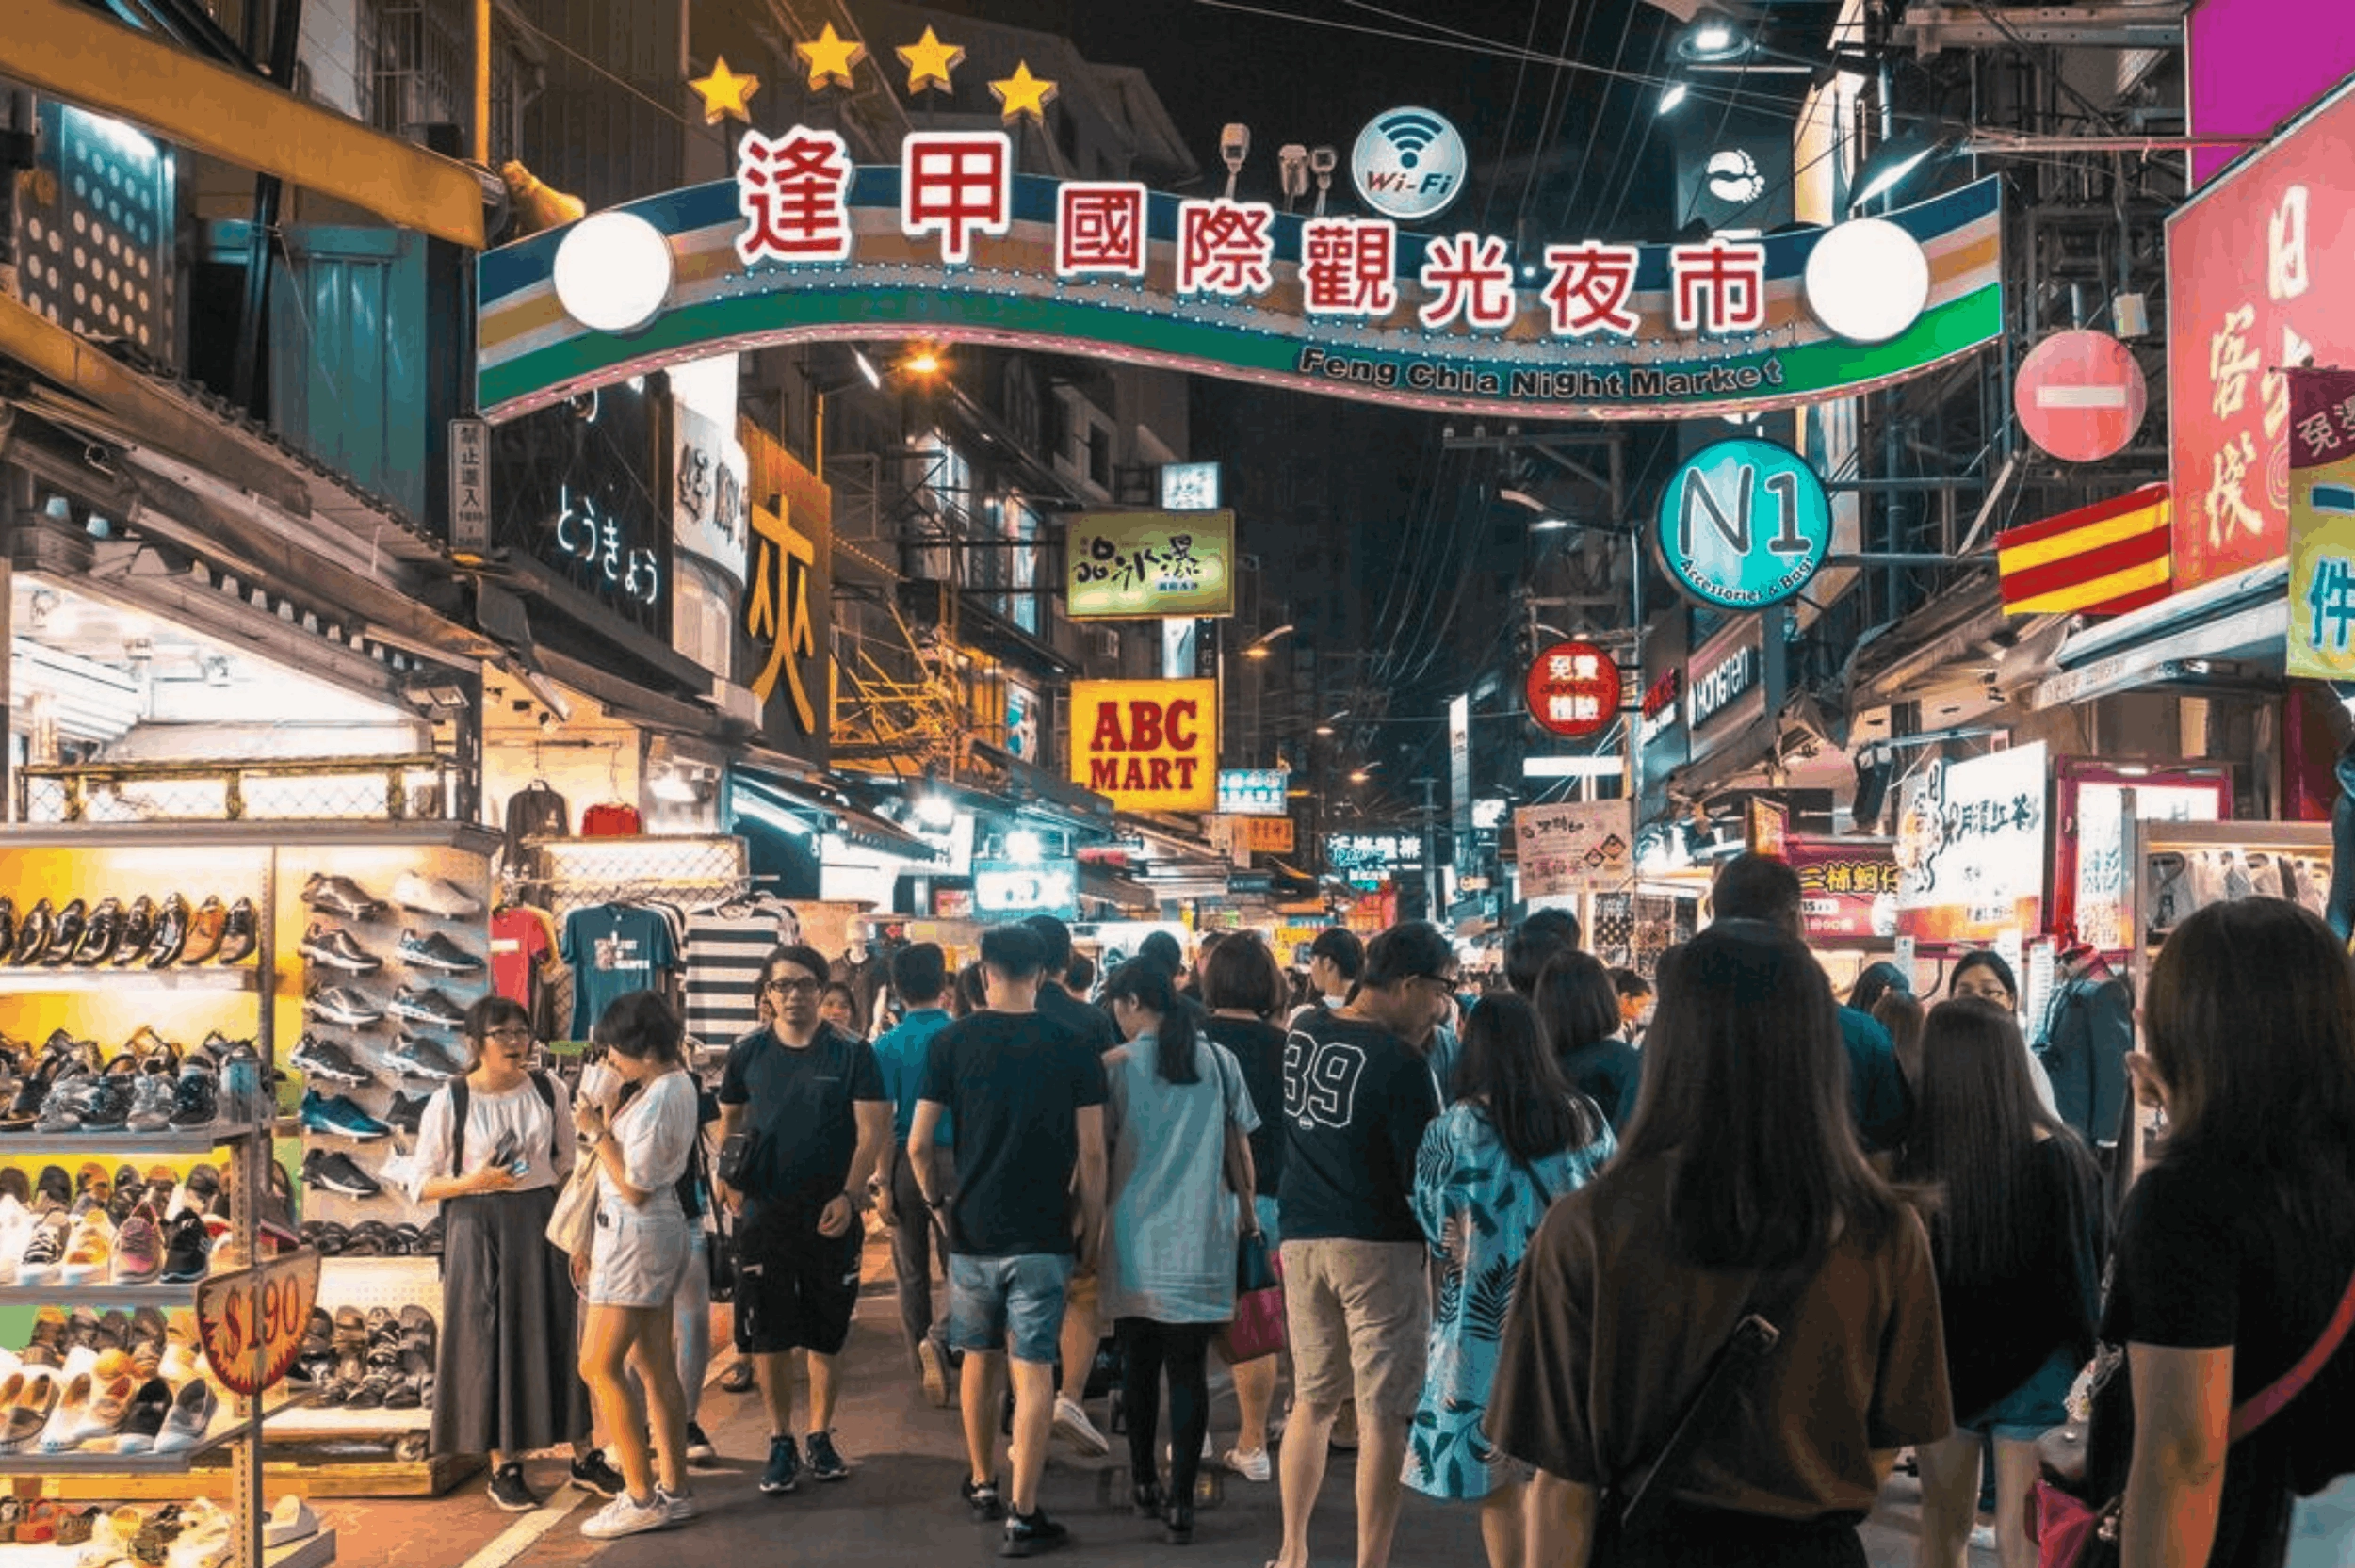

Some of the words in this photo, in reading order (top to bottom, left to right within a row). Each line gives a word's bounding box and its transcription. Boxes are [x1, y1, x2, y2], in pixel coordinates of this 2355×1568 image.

[1367, 171, 1453, 194] Wi-Fi
[738, 126, 1766, 335] 逢甲國際觀光夜市
[1299, 347, 1400, 387] Feng
[1405, 362, 1500, 395] Chia
[1510, 368, 1623, 398] Night
[1628, 356, 1784, 396] Market
[1679, 464, 1812, 556] N1
[1680, 558, 1763, 603] Accessories
[1548, 655, 1599, 681] 免費
[1090, 699, 1198, 752] ABC
[1090, 757, 1198, 791] MART
[1283, 1029, 1368, 1128] 39
